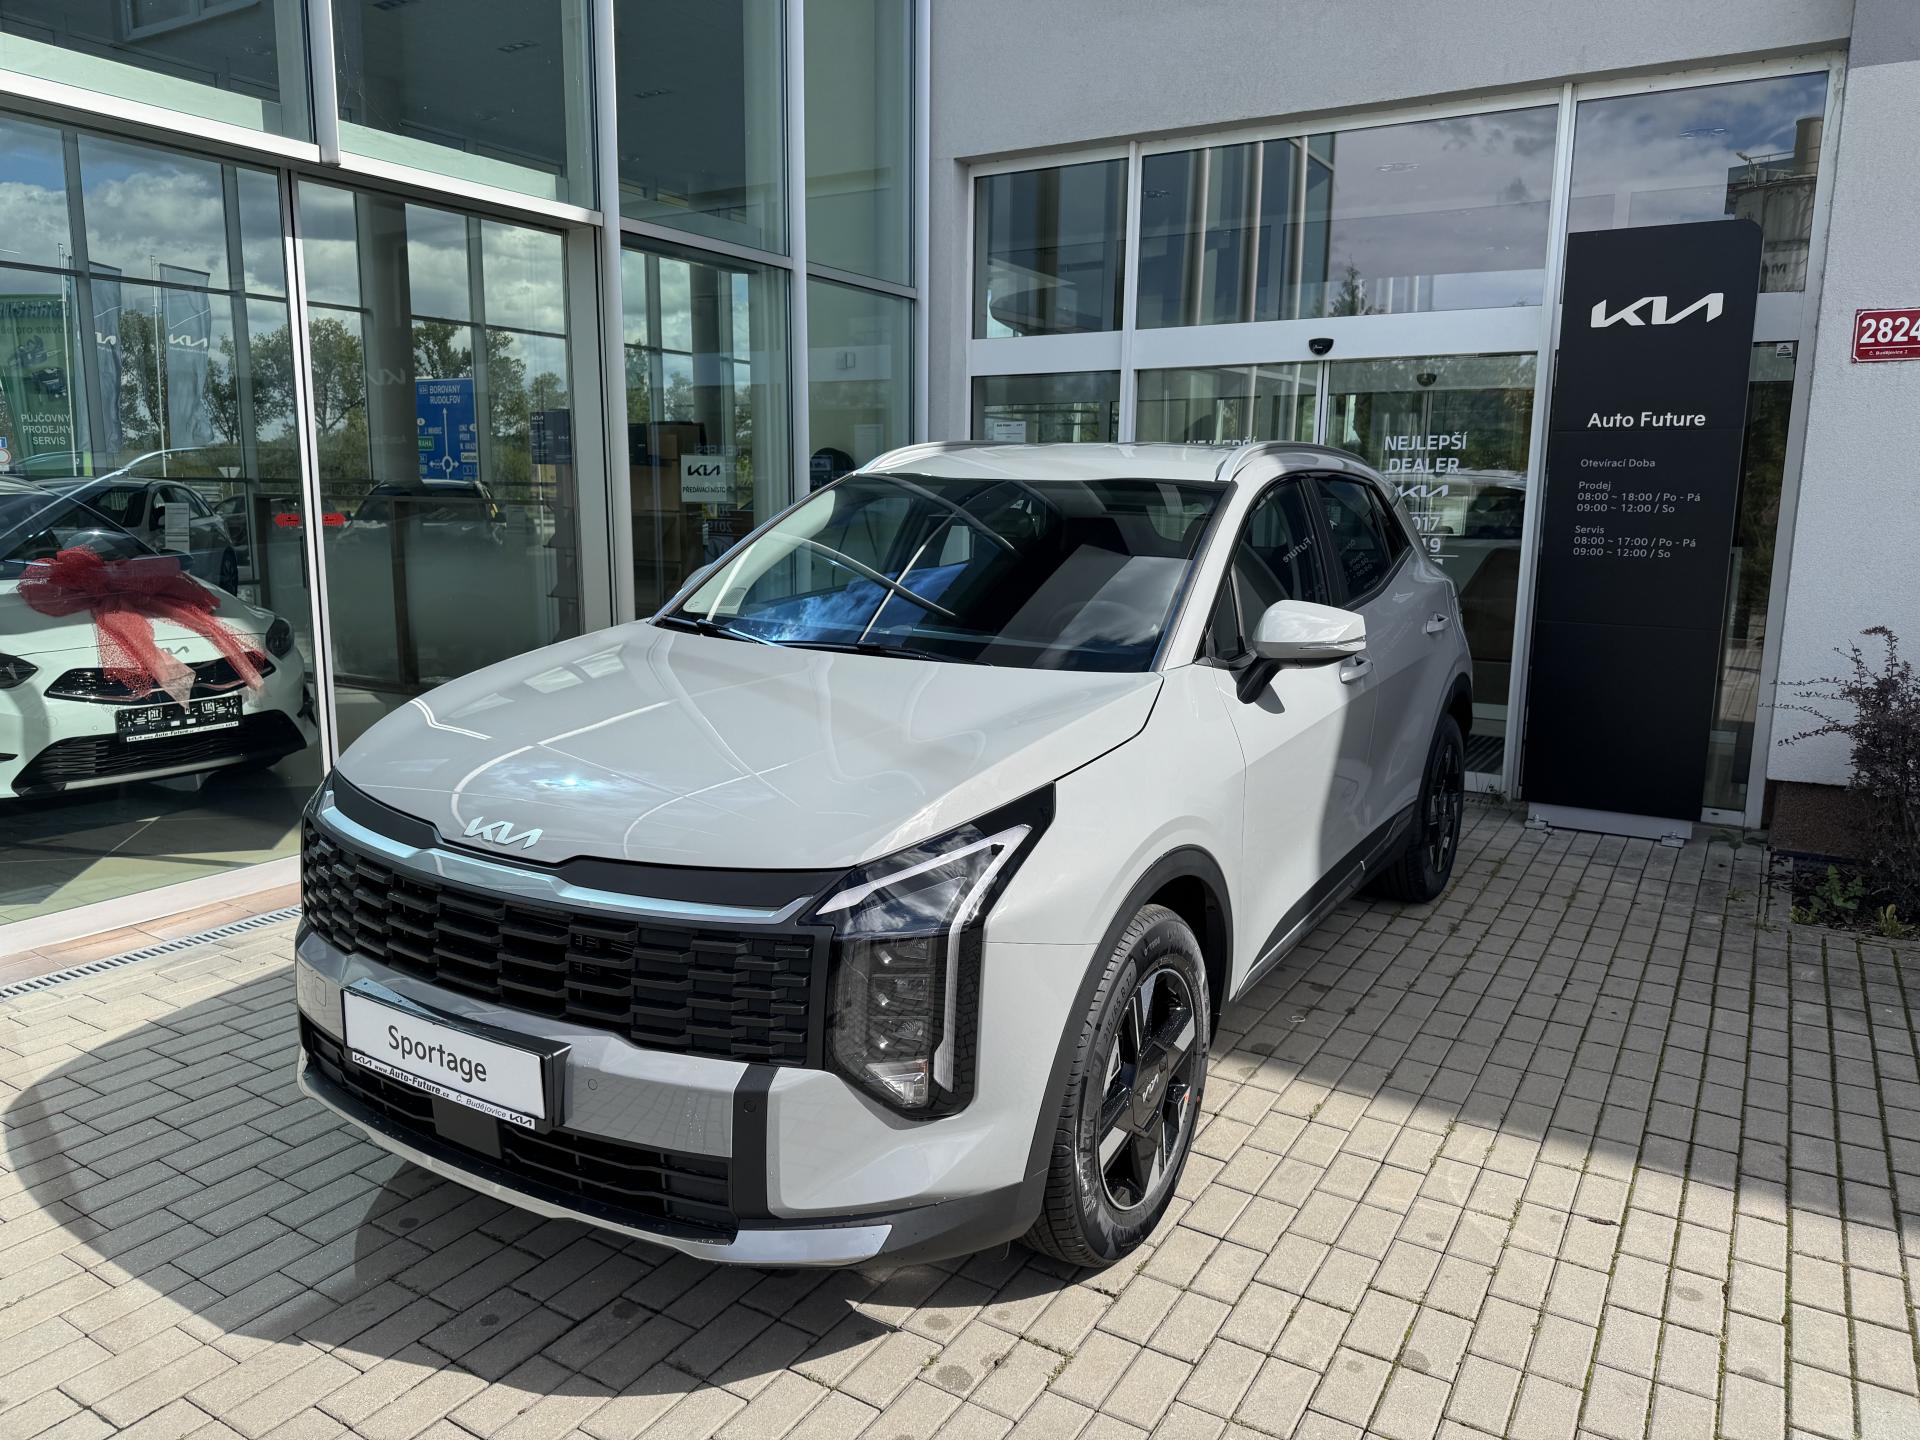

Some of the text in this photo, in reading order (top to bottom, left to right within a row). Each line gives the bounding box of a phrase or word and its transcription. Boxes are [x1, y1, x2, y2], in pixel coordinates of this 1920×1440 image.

[1591, 293, 1724, 328] KIA
[1860, 317, 1920, 344] 2824
[1587, 411, 1706, 428] Auto Future
[32, 436, 66, 446] SERVIS
[1384, 431, 1468, 451] NEJLEPŠÍ
[1388, 457, 1460, 474] DEALER
[1580, 459, 1656, 468] Otevírací Doba
[687, 464, 721, 477] KIA
[1578, 481, 1612, 492] Prodej
[1577, 492, 1609, 501] 08:00
[1621, 492, 1653, 502] 18:00
[1662, 492, 1677, 502] Po
[1686, 492, 1701, 502] Pá
[1576, 503, 1608, 513] 09:00
[1621, 503, 1652, 513] 12:00
[1662, 504, 1676, 513] So
[1574, 525, 1606, 535] Servis
[1573, 536, 1605, 546] 08:00
[1617, 537, 1649, 547] 17:00
[1658, 537, 1673, 548] Po
[1682, 537, 1697, 548] Pá
[1572, 547, 1604, 557] 09:00
[1617, 548, 1648, 558] 12:00
[1657, 549, 1672, 558] So
[464, 816, 543, 848] KIA
[387, 1025, 488, 1083] Sportage
[509, 1113, 533, 1127] KIA
